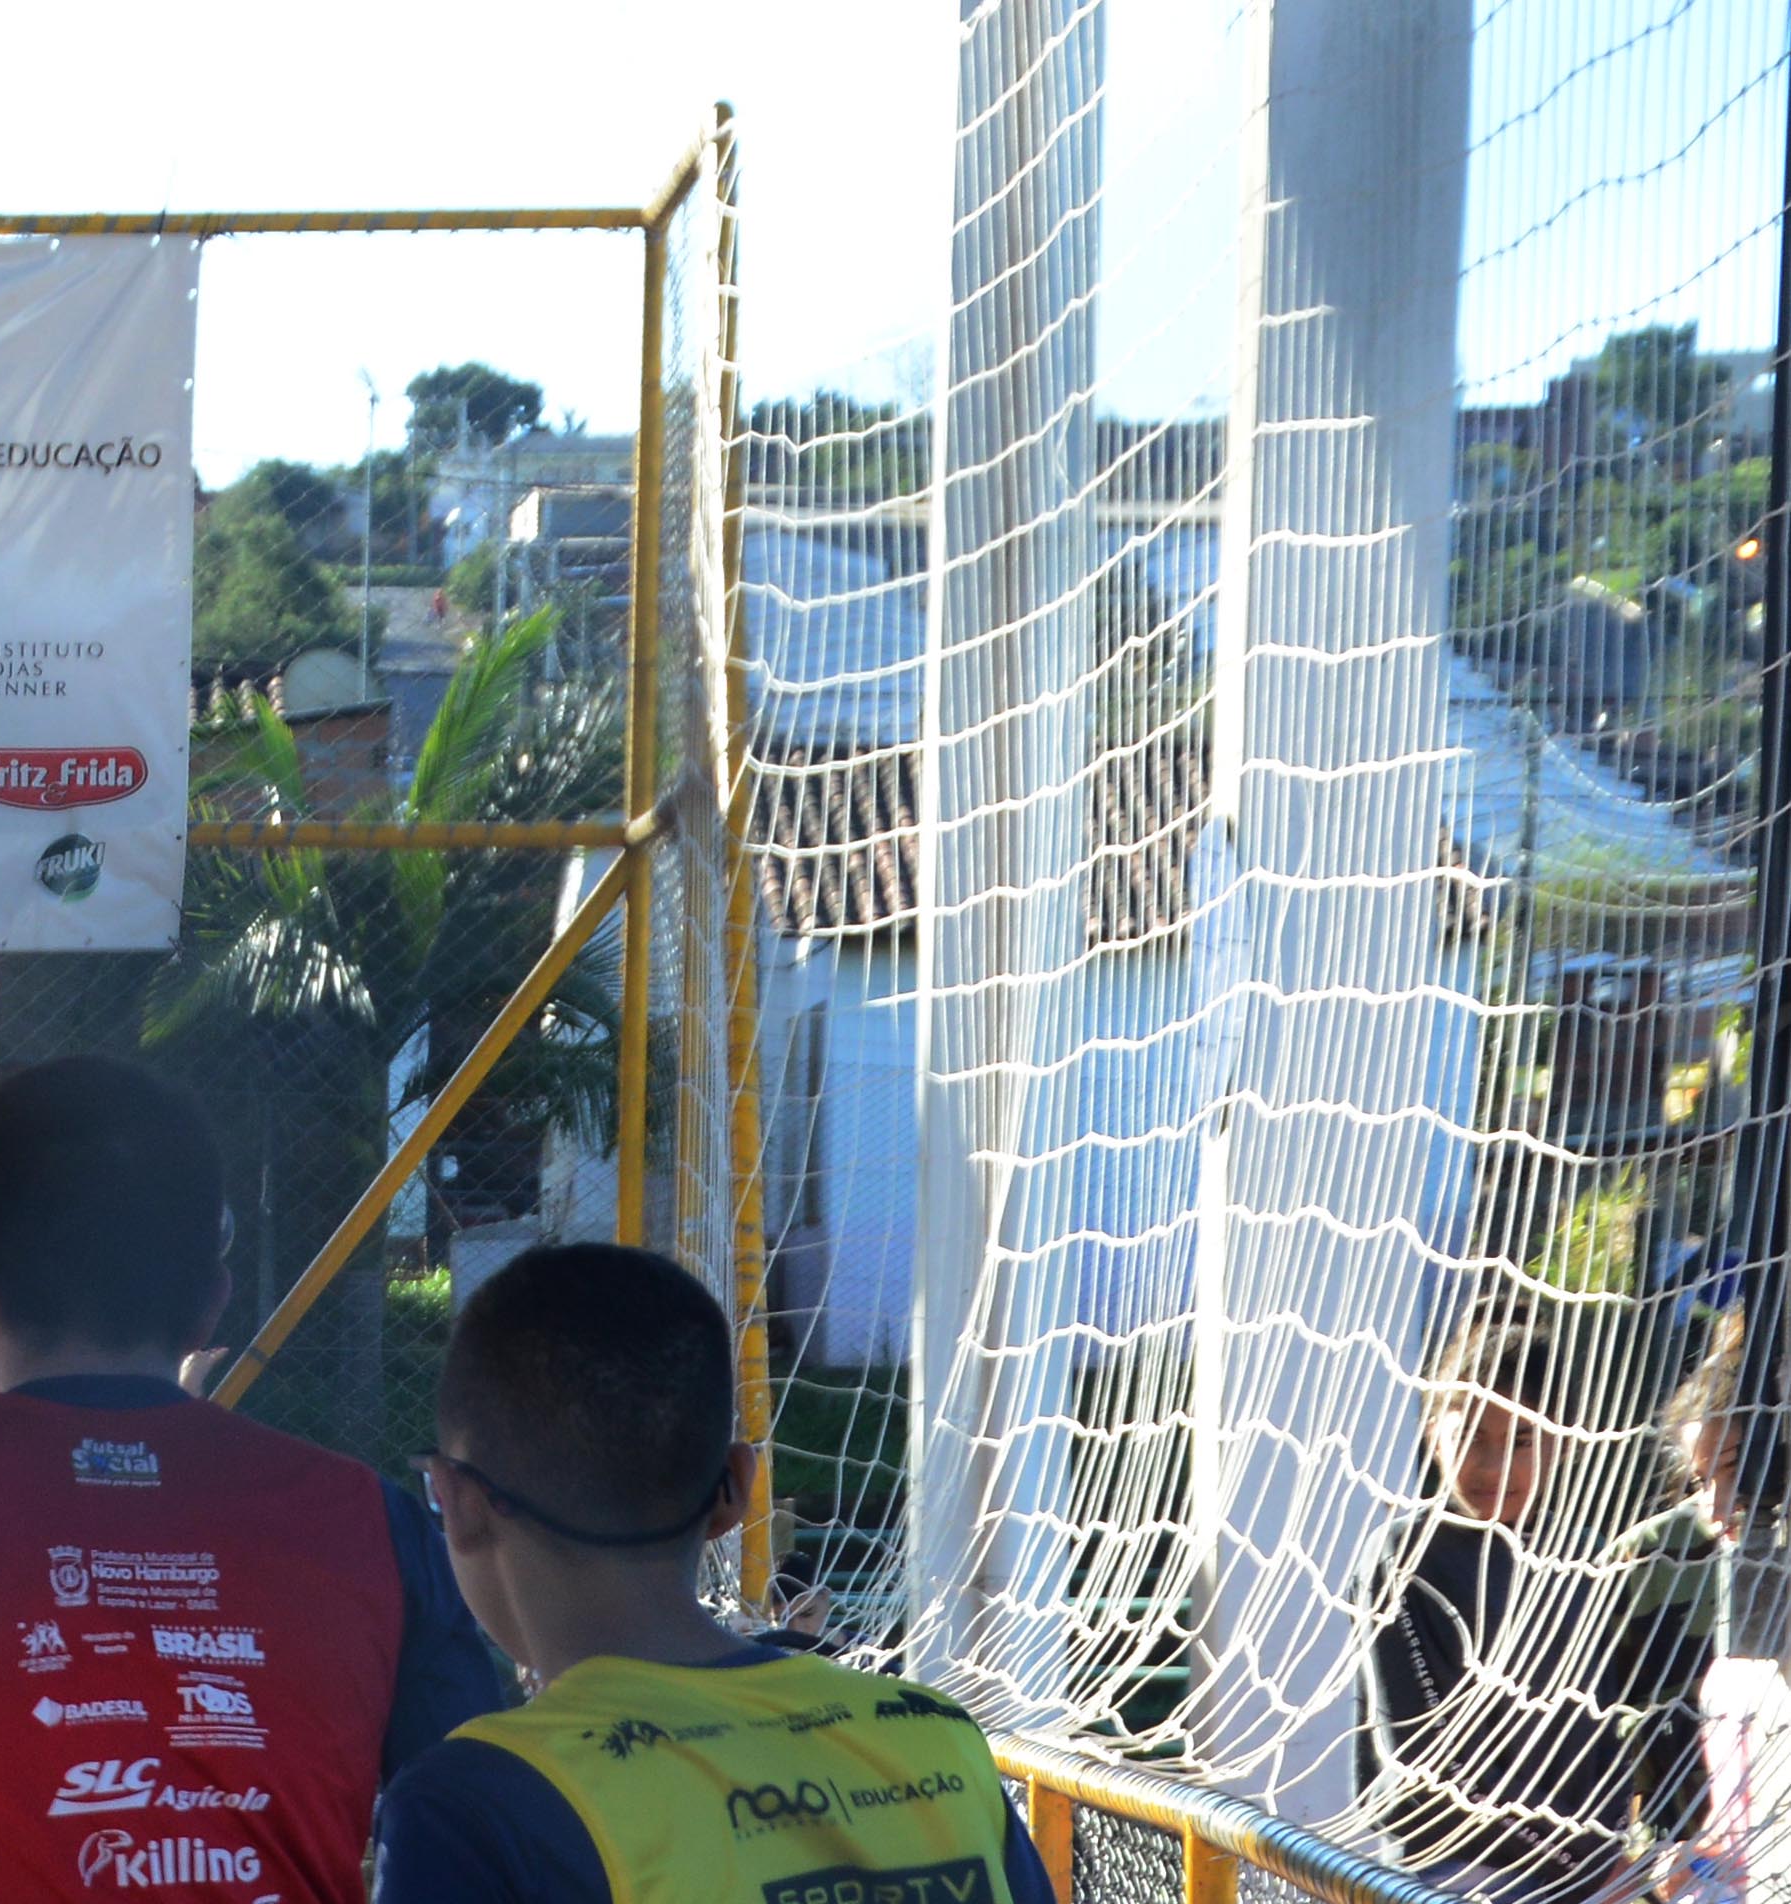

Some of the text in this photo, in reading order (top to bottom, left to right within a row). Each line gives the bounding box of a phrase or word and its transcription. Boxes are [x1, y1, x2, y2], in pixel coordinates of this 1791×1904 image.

[61, 758, 134, 787] Frida
[34, 841, 107, 883] FRUKI
[91, 1563, 220, 1585] Novo Hamburgo
[152, 1628, 266, 1661] BRASIL
[56, 1757, 161, 1798] SLC
[849, 1771, 965, 1809] EDUCAÇÃO
